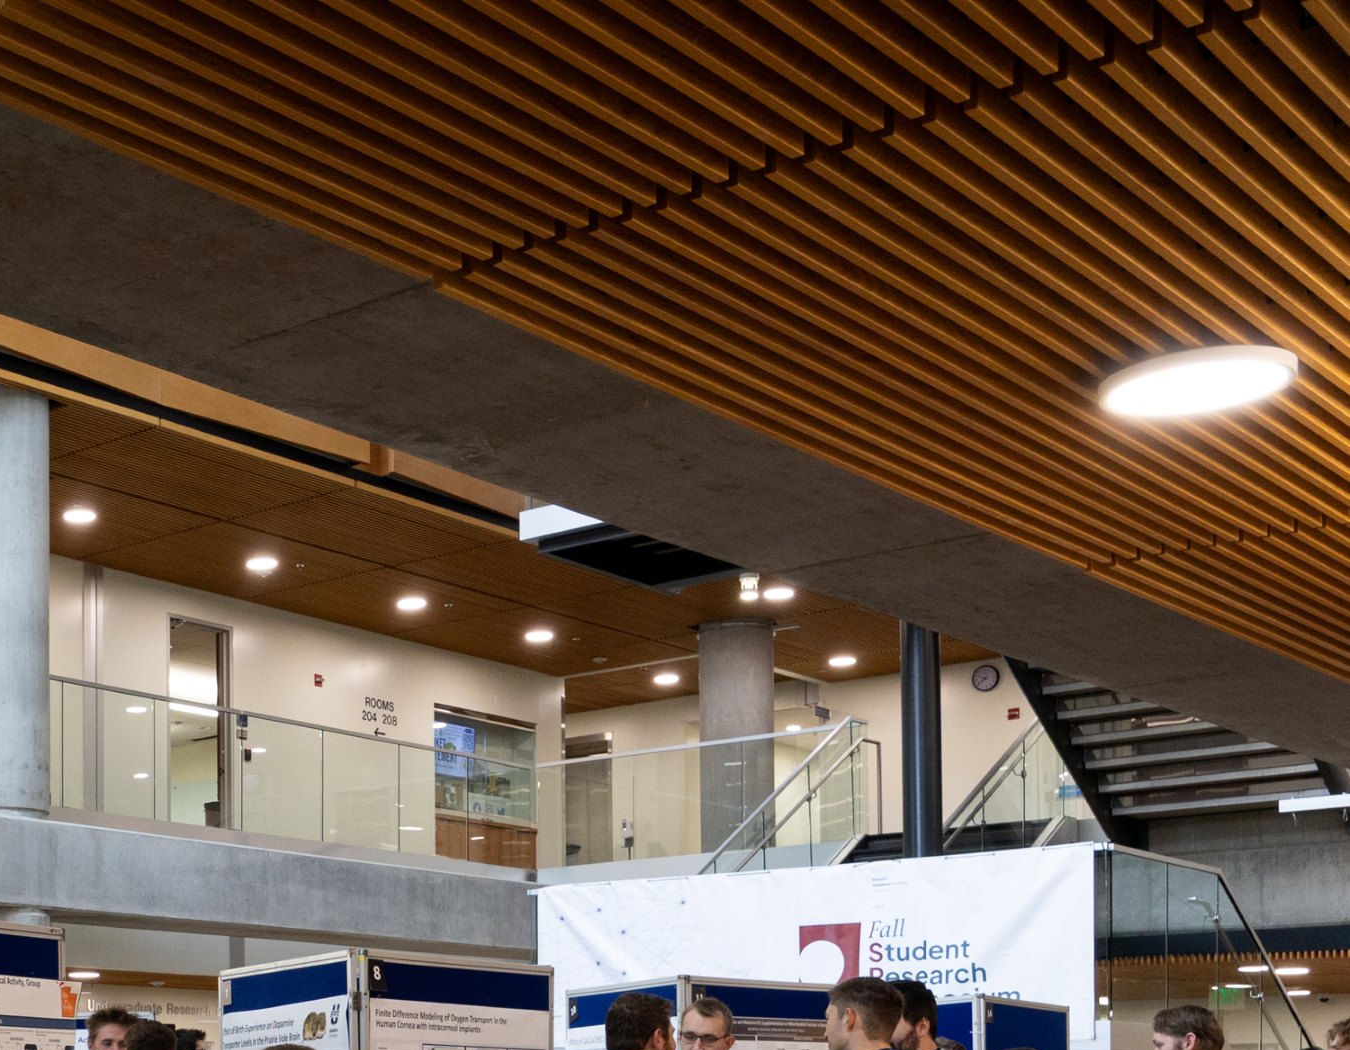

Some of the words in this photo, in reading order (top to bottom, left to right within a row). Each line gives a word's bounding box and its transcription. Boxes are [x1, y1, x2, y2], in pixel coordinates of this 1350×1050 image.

[365, 696, 394, 712] ROOMS
[362, 710, 377, 723] 204
[382, 714, 398, 727] 208
[868, 918, 905, 939] Fall
[869, 940, 970, 963] Student
[373, 965, 382, 981] 8
[869, 962, 987, 986] Research
[7, 977, 25, 987] Activity,
[26, 979, 41, 988] Group
[375, 1008, 391, 1018] Finite
[392, 1009, 419, 1020] Difference
[420, 1012, 443, 1023] Modeling
[444, 1013, 450, 1021] of
[451, 1014, 469, 1024] Oxygen
[469, 1015, 493, 1026] Transport
[375, 1020, 396, 1028] Human
[397, 1020, 415, 1029] Cornea
[416, 1021, 428, 1030] with
[245, 1022, 266, 1034] Experience
[272, 1019, 295, 1031] Dopamine
[241, 1038, 252, 1048] Levels
[289, 1032, 301, 1041] Brain
